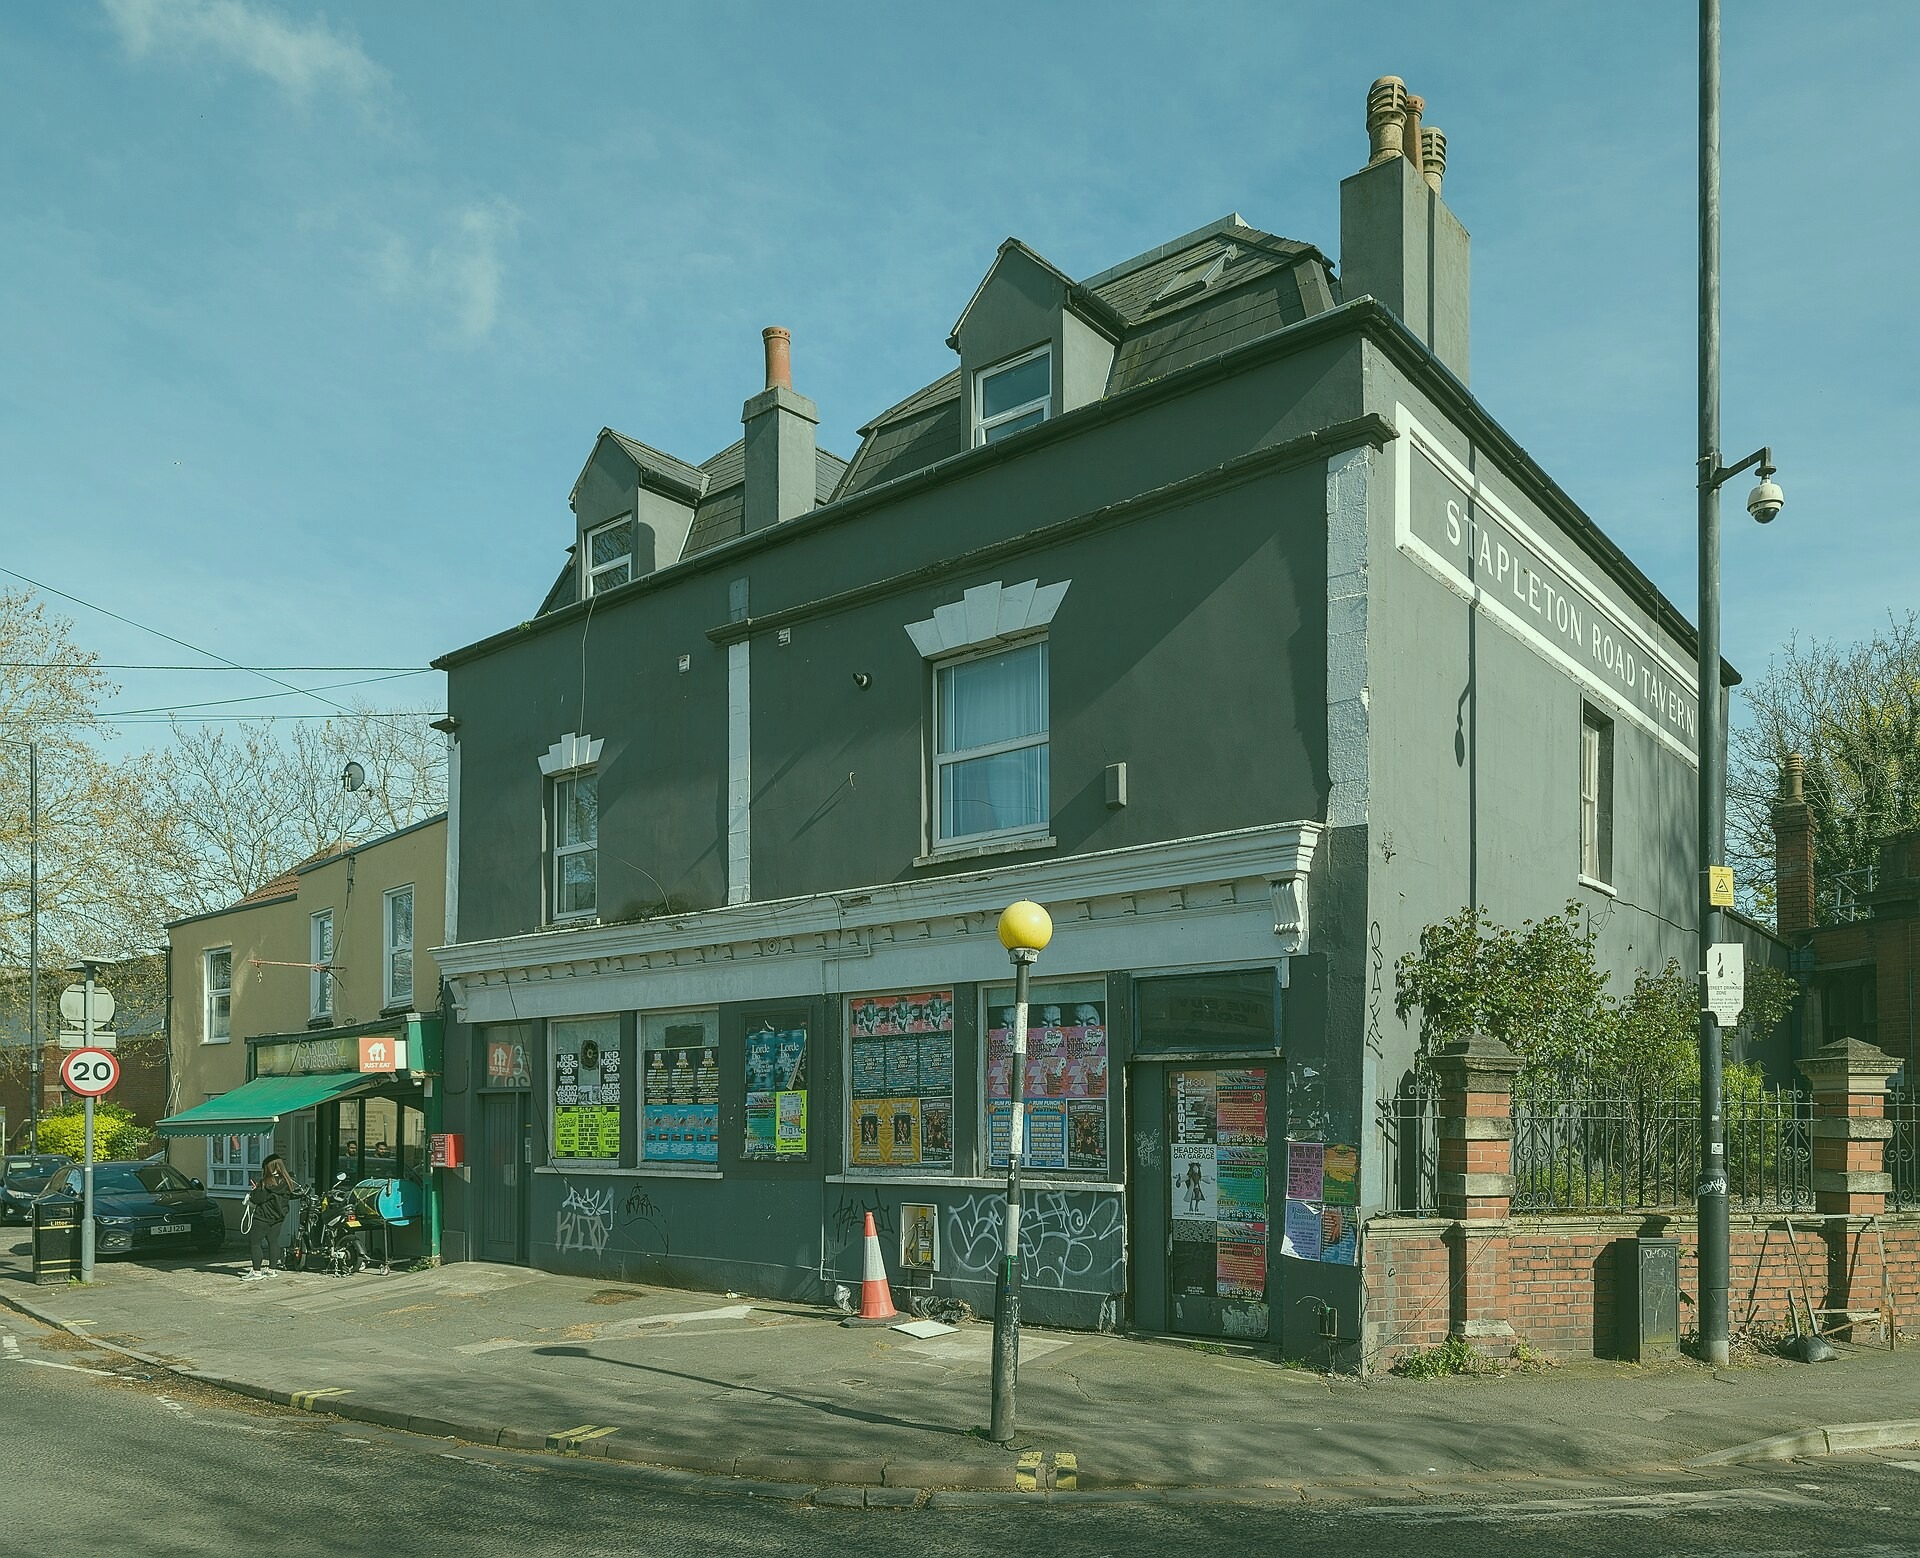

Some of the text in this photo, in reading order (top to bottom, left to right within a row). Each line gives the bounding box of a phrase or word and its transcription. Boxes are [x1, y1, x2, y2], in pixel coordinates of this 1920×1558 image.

[1446, 499, 1695, 738] STAPLETON ROAD TAVERN
[752, 1044, 770, 1053] Lorde
[781, 1042, 800, 1052] Lorde
[73, 1062, 110, 1080] 20
[557, 1096, 577, 1104] SHOW
[1178, 1073, 1186, 1144] HOSPITAL
[1010, 1160, 1017, 1170] T
[1010, 1172, 1015, 1180] 4
